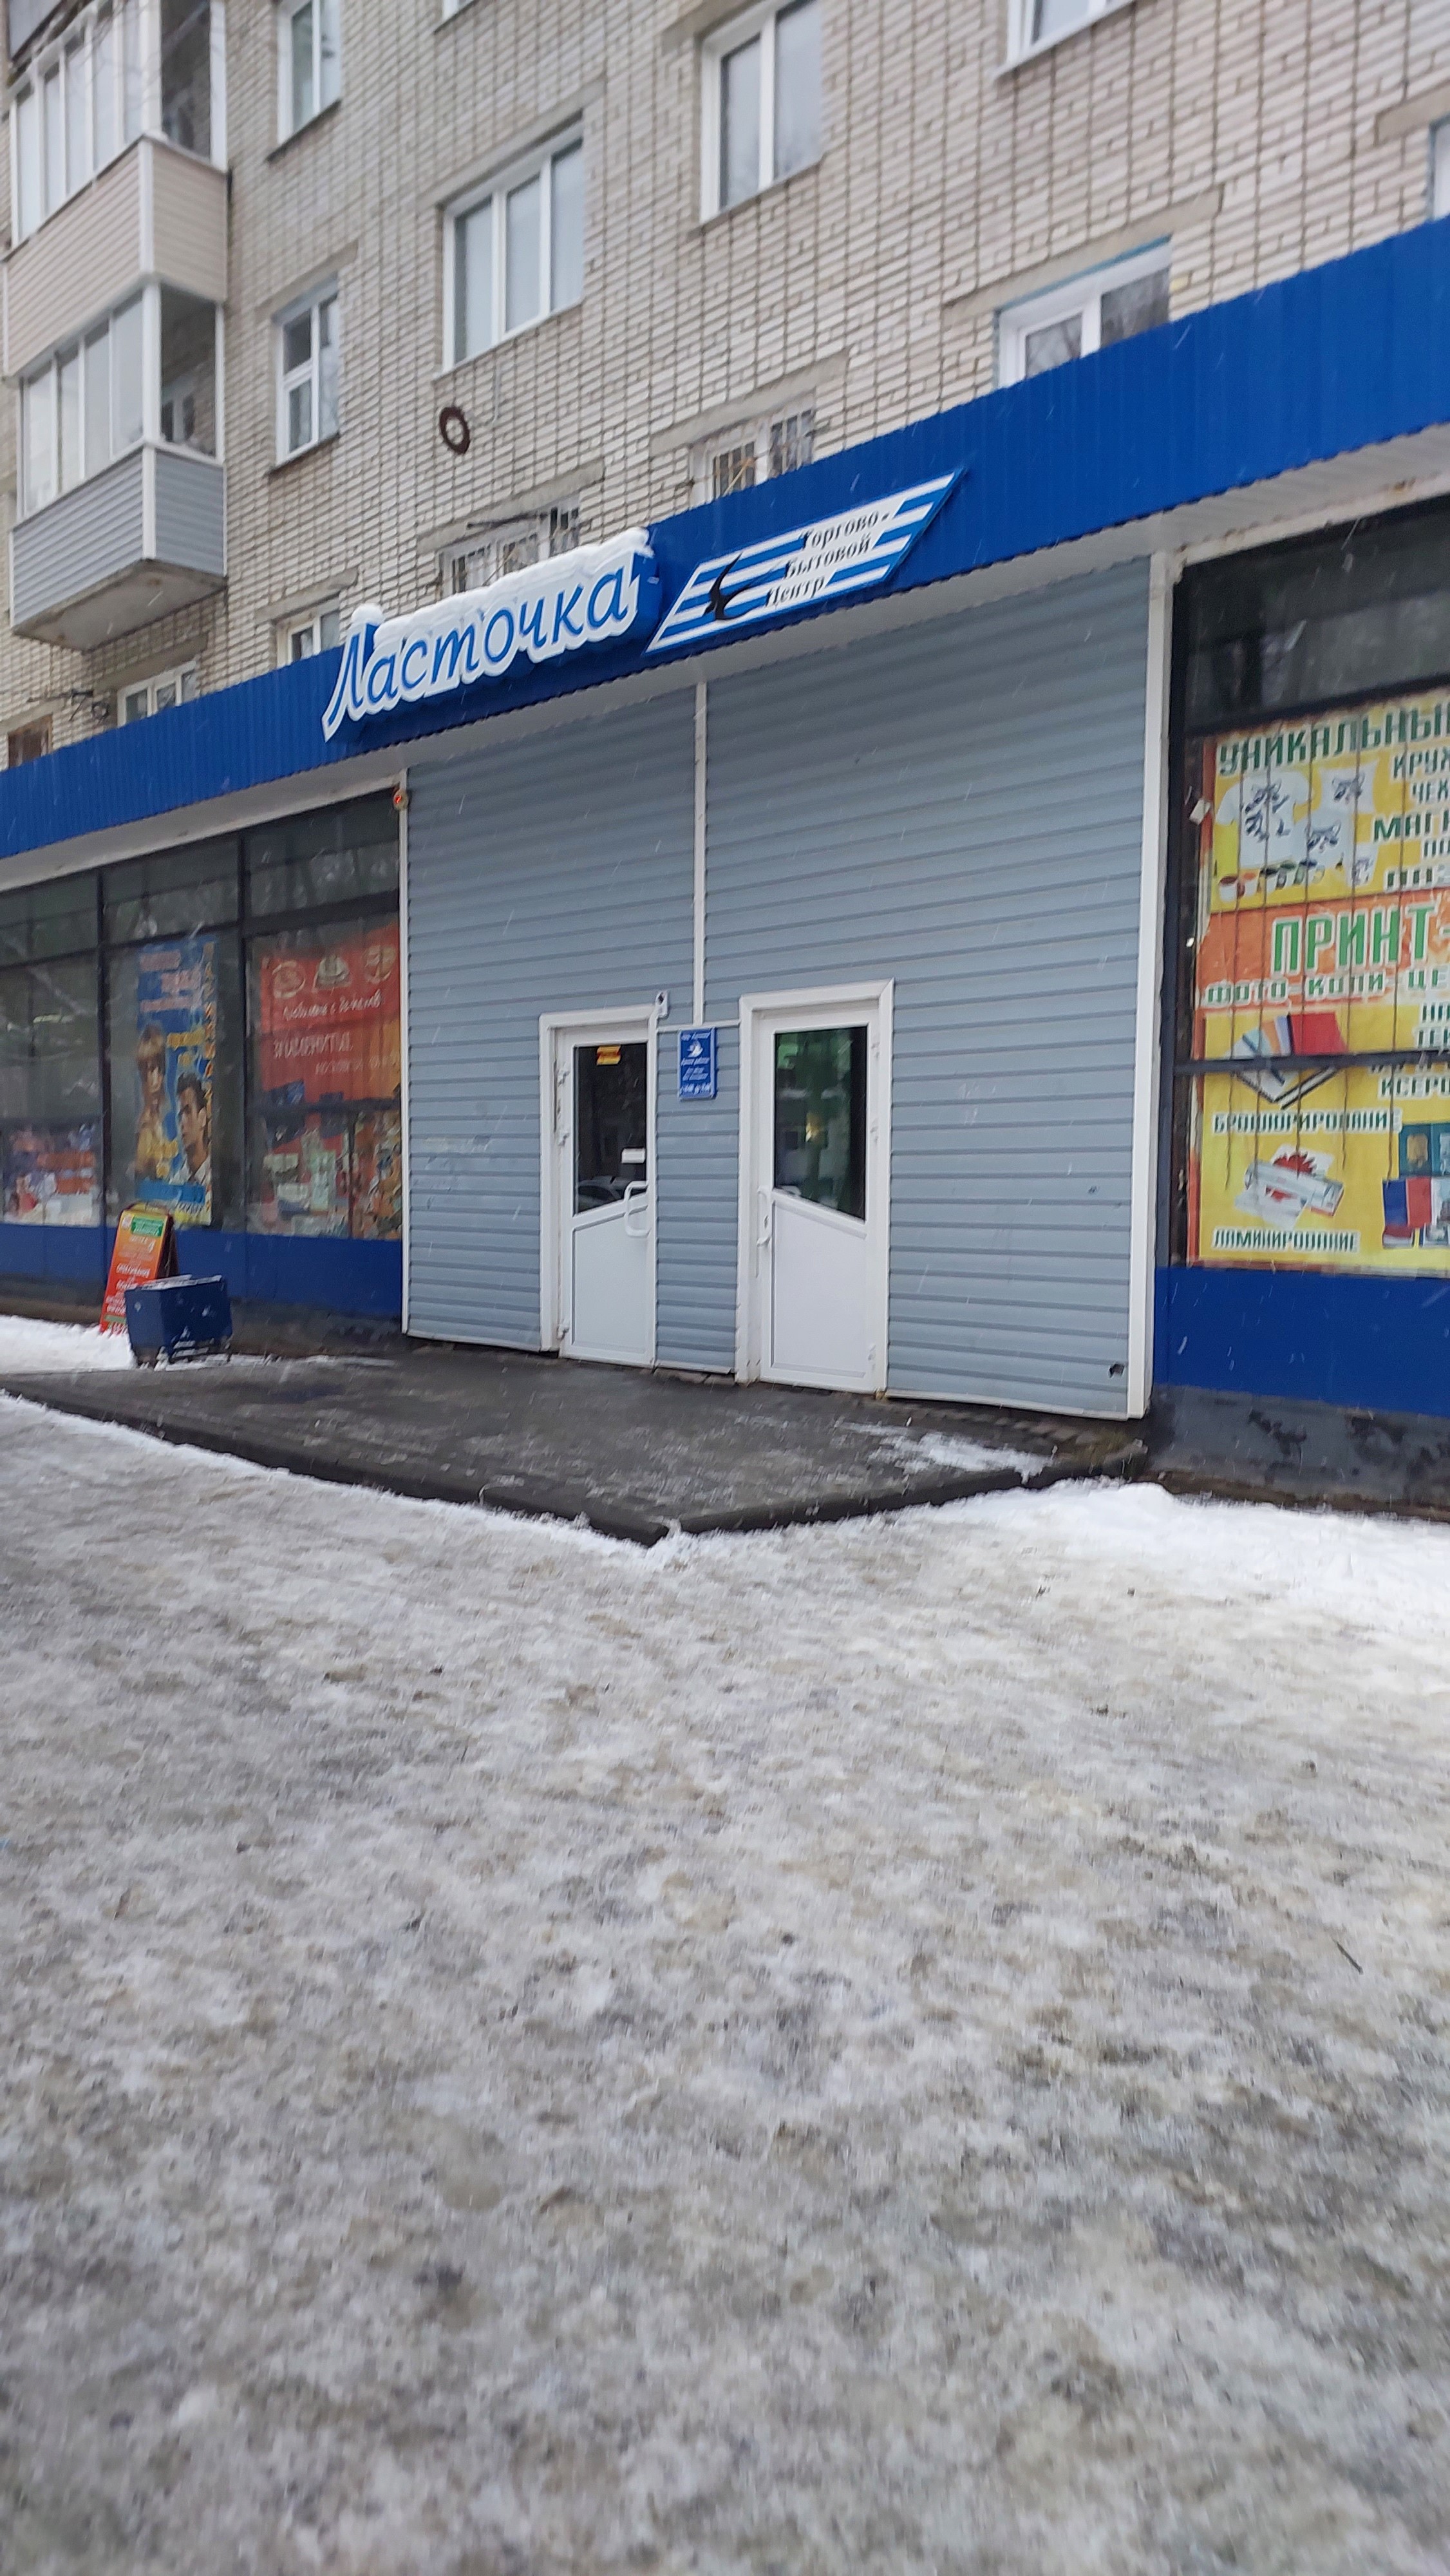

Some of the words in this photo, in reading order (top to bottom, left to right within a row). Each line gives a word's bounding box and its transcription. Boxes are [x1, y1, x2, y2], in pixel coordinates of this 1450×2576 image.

[783, 533, 871, 579] Бытовой
[764, 576, 825, 610] Центр
[326, 566, 629, 728] Ласточка
[1219, 701, 1450, 774] УНИКАЛЬНЫ
